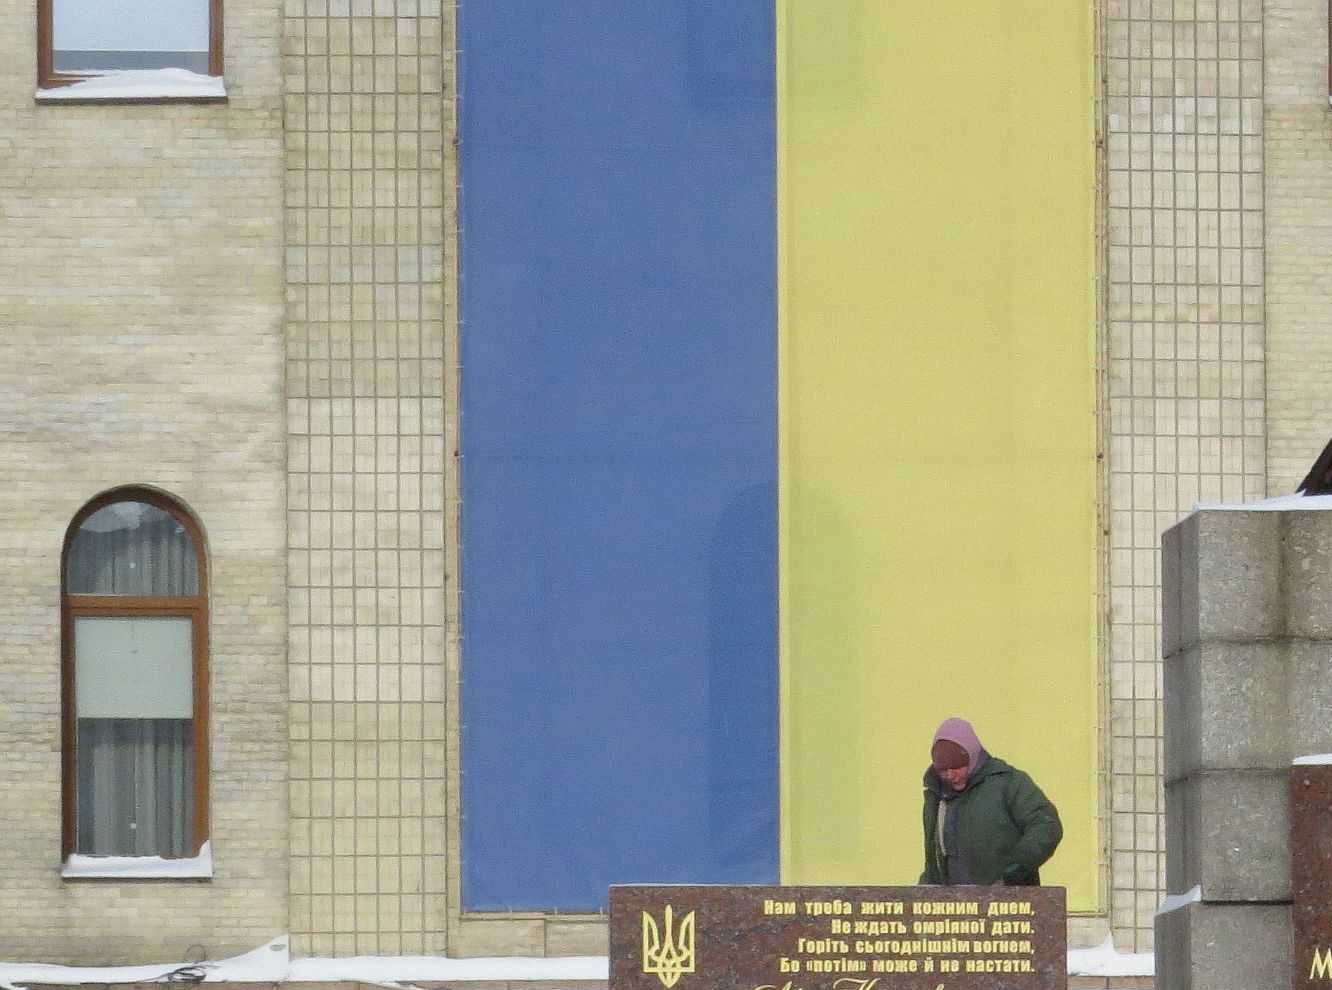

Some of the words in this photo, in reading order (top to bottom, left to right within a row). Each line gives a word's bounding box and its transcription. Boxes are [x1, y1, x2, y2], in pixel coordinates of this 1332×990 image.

[763, 900, 797, 915] Нам
[804, 900, 853, 916] треба
[860, 901, 904, 915] жити
[912, 901, 979, 915] кожним
[987, 901, 1035, 917] днем,
[830, 919, 851, 934] Не
[854, 920, 907, 935] ждать
[913, 919, 986, 936] омріяної
[991, 920, 1035, 936] дати.
[798, 938, 849, 954] Горіть
[855, 938, 970, 955] сьогоднішнім
[973, 940, 1035, 955] вогнем,
[780, 957, 800, 973] Бо
[873, 959, 918, 973] може
[924, 957, 934, 973] й
[940, 959, 960, 973] не
[966, 959, 1035, 973] настати.
